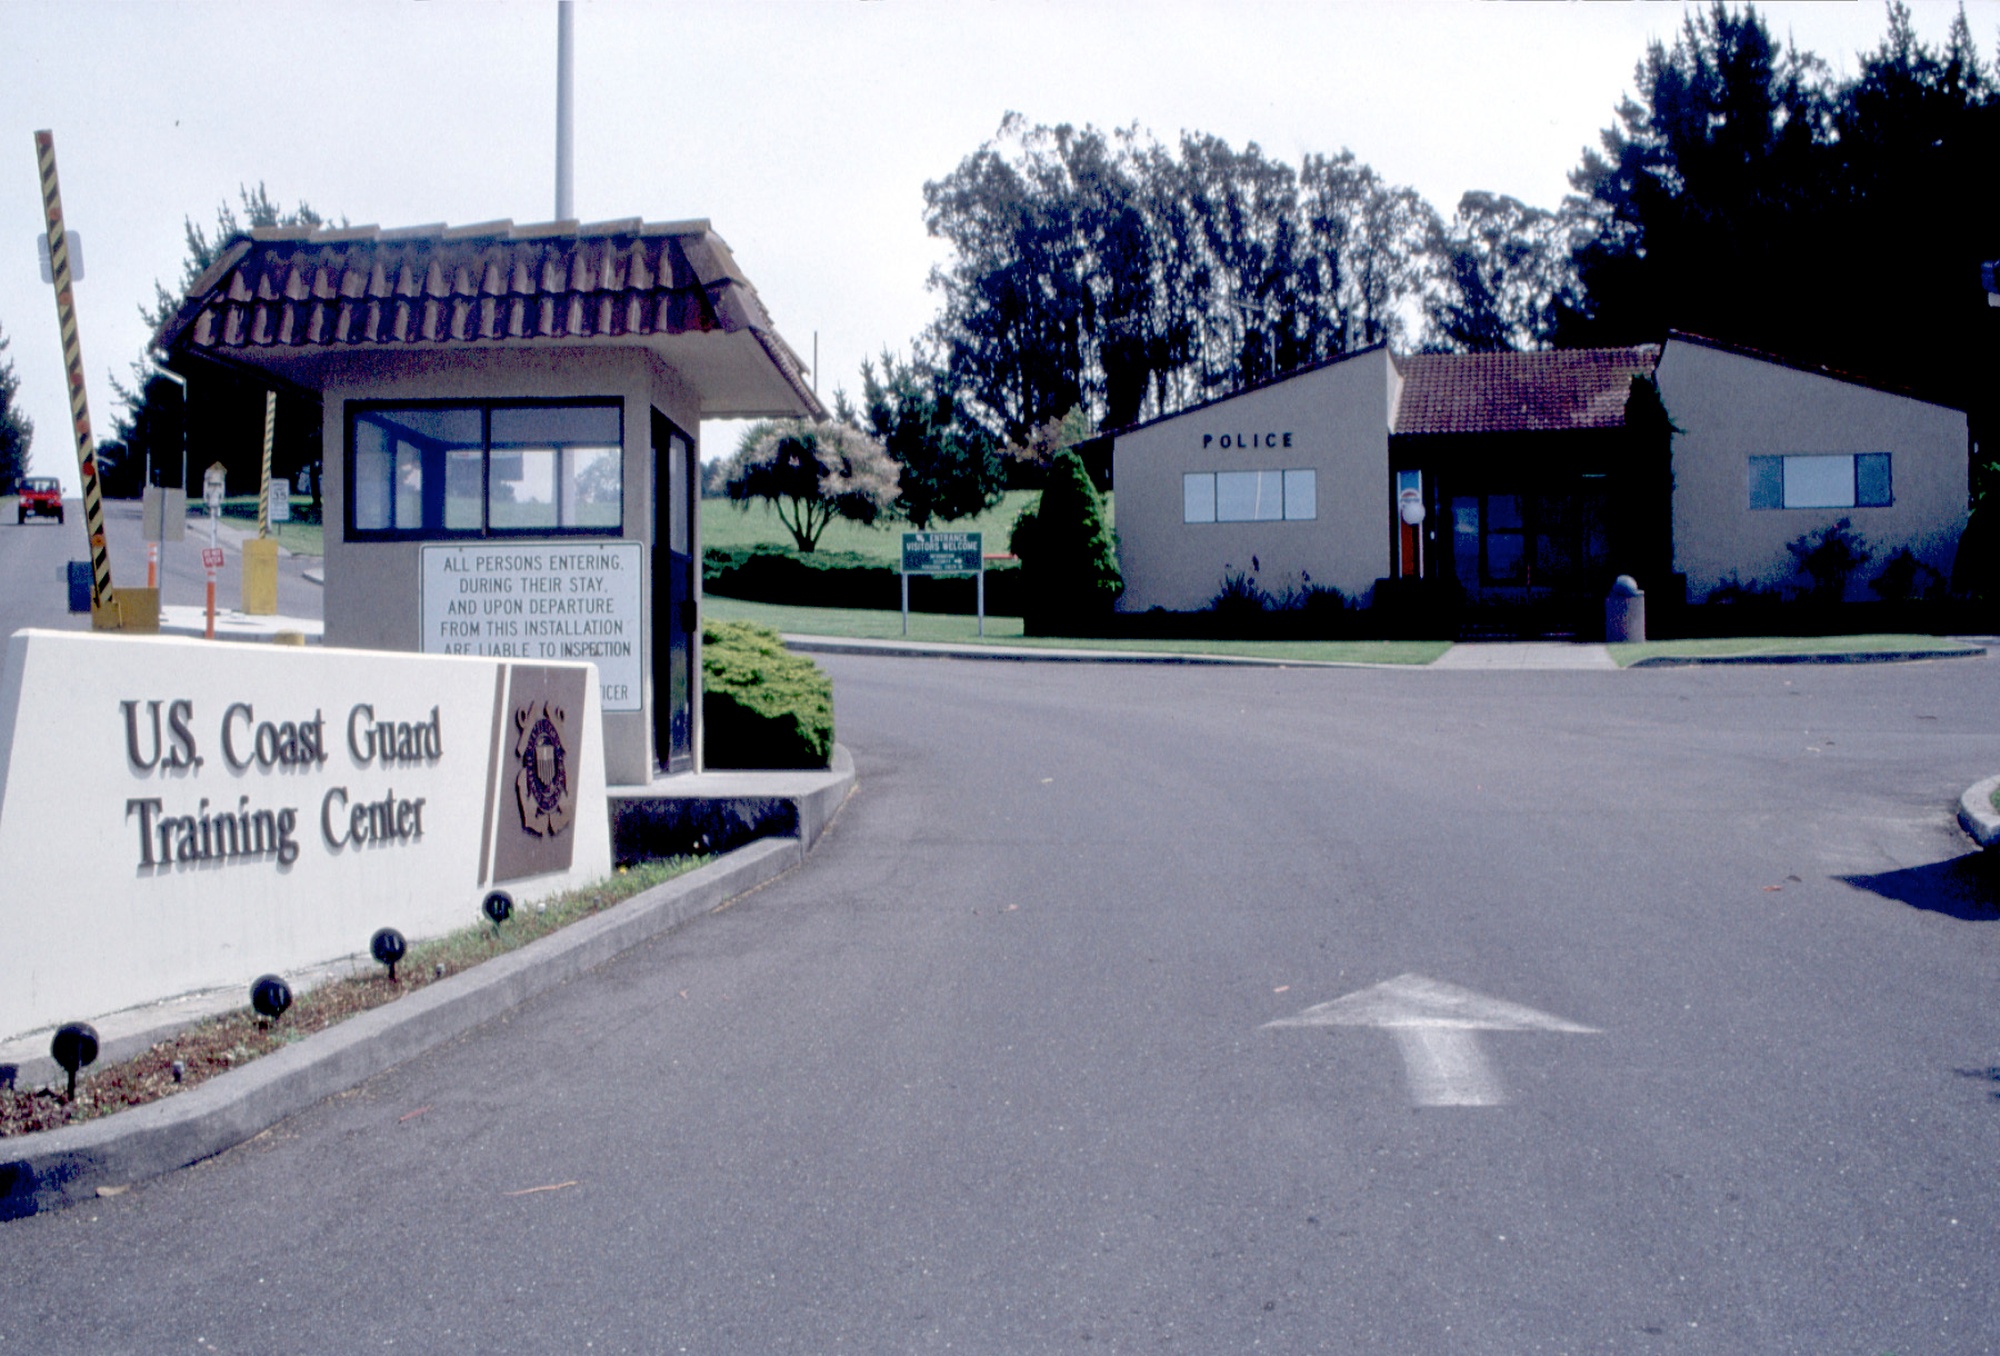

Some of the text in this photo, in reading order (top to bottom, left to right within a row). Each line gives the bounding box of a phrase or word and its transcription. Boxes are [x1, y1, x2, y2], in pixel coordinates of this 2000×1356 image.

[1203, 432, 1293, 449] POLICE
[906, 541, 978, 551] VISITORS WELCOME
[930, 534, 967, 542] ENTRANCE
[444, 557, 470, 572] ALL
[476, 555, 542, 572] PERSONS
[459, 578, 513, 594] DURING
[521, 577, 562, 593] THEIR
[448, 598, 614, 615] AND UPON DEPARTURE
[441, 619, 623, 637] FROM THIS INSTALLATION
[479, 642, 530, 657] LIABLE
[539, 642, 557, 656] TO
[560, 640, 631, 657] INSPECTION
[119, 699, 444, 771] U.S. Coast Guard
[125, 786, 426, 866] Training Center
